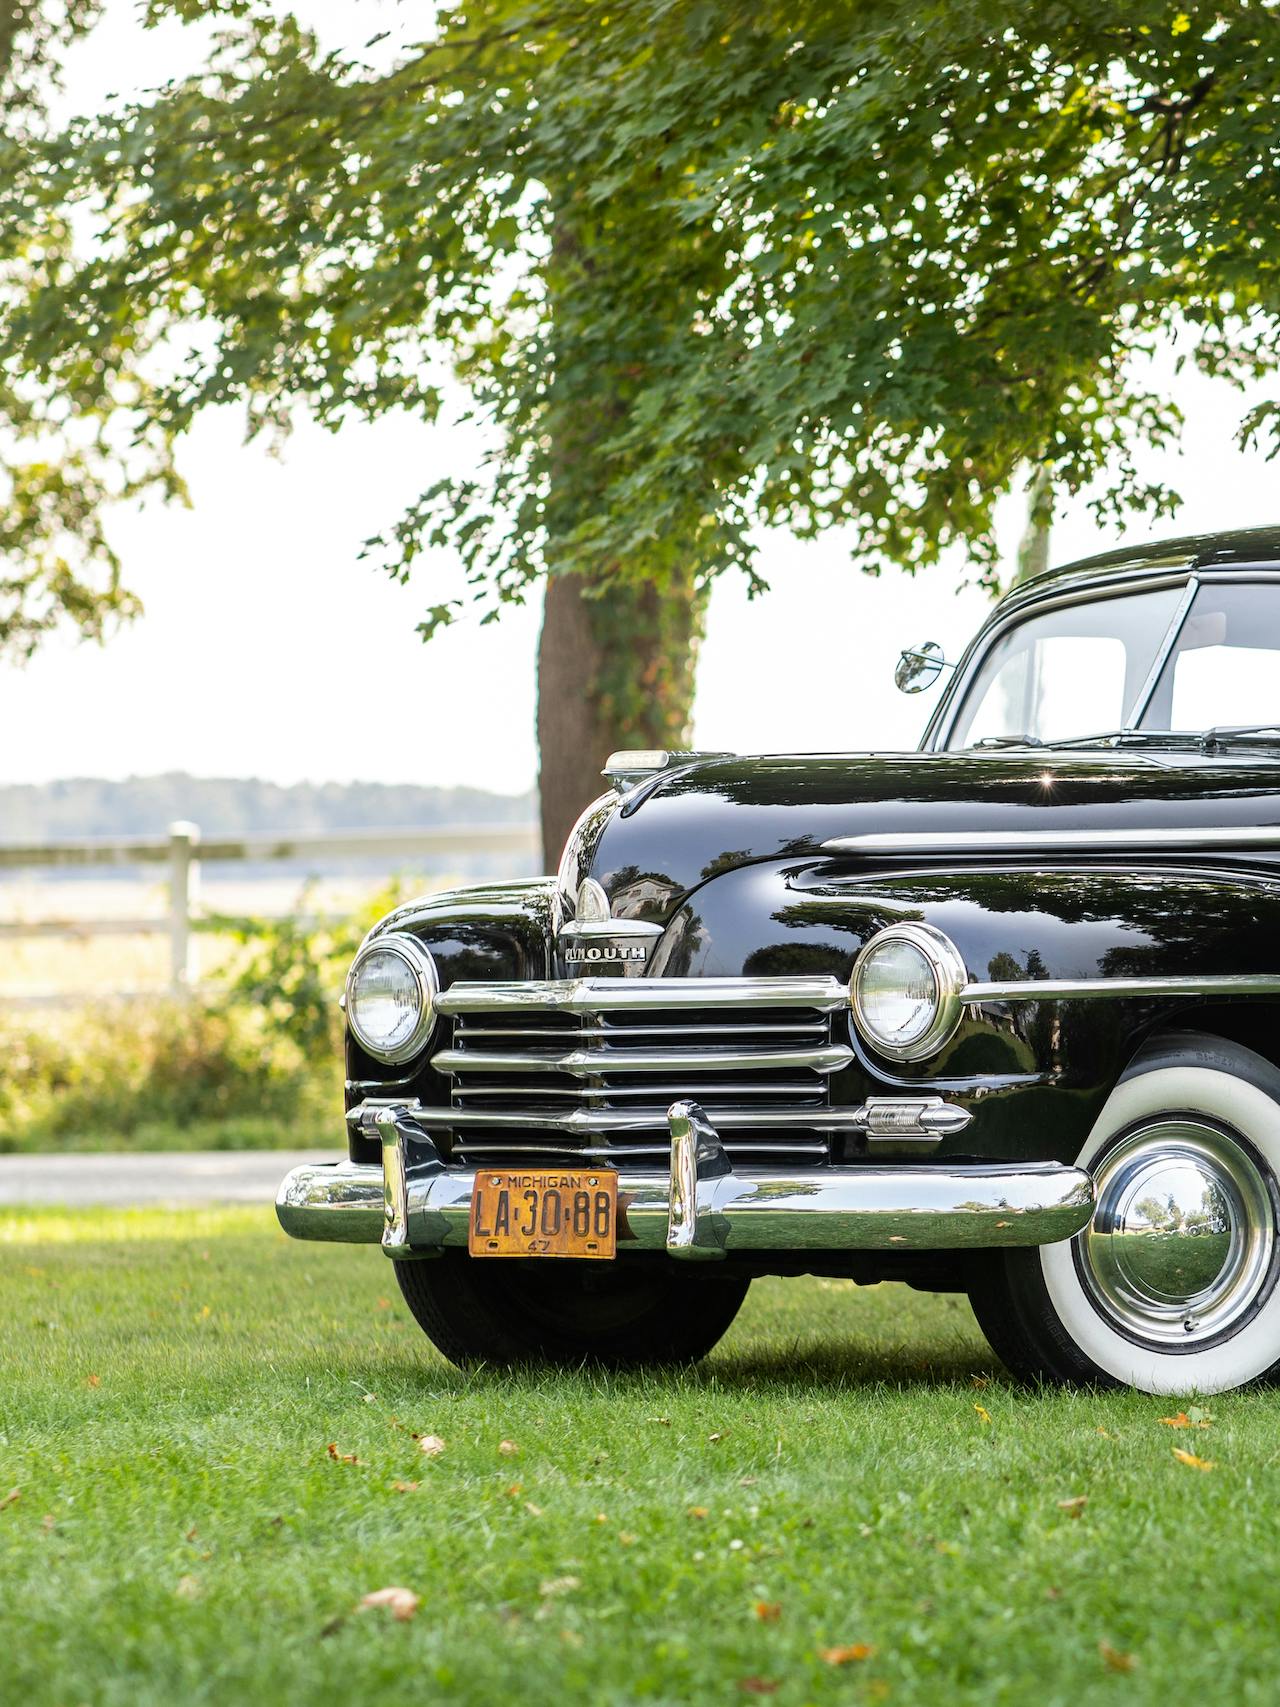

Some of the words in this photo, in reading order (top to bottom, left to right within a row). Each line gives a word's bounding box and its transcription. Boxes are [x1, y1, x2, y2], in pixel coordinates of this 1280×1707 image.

[565, 947, 646, 961] PLYMOUTH
[507, 1176, 581, 1188] MICHIGAN
[528, 1240, 550, 1251] 47
